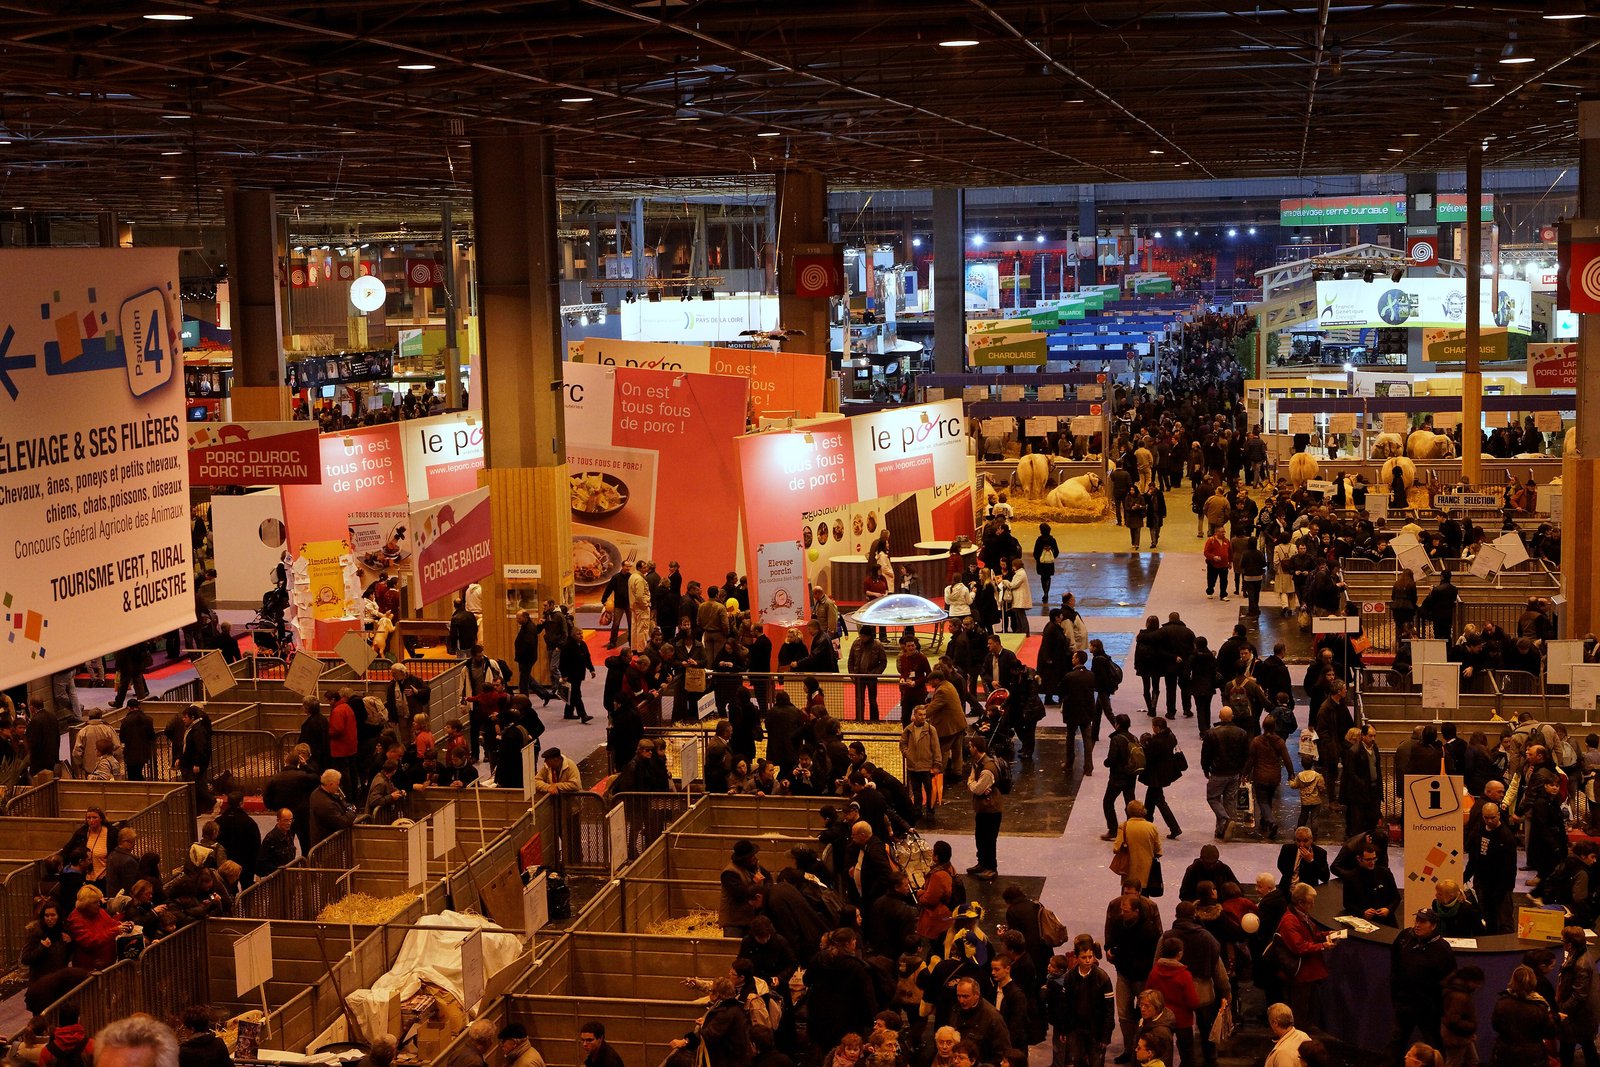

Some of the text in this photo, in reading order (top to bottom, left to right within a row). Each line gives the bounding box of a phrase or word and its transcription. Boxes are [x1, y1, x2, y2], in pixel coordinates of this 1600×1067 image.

[134, 310, 143, 376] Pavillon
[144, 310, 163, 374] 4
[1443, 346, 1496, 354] CHAAISE
[598, 351, 615, 366] le
[715, 360, 757, 376] On est
[622, 382, 670, 399] On est
[621, 400, 691, 417] tous fous
[620, 417, 638, 430] de
[643, 420, 675, 434] porc
[871, 414, 960, 452] le porc
[74, 432, 85, 460] &
[89, 426, 117, 458] SES
[121, 414, 179, 451] FILIÈRES
[368, 438, 390, 453] est
[421, 430, 443, 454] le
[822, 434, 843, 449] est
[206, 451, 300, 463] PORC DUROC
[578, 457, 592, 466] TOUS
[595, 459, 611, 468] FOUS
[613, 460, 620, 469] DE
[816, 454, 844, 468] fous
[879, 458, 931, 472] www.leporc.com
[47, 476, 73, 495] ânes,
[76, 472, 107, 493] poneys
[110, 466, 118, 482] et
[121, 462, 144, 482] petits
[146, 455, 180, 475] chevaux,
[200, 465, 308, 478] PORC PIETRAIN
[326, 456, 392, 477] tous fous
[333, 480, 350, 493] de
[355, 474, 384, 492] porc
[789, 477, 805, 491] de
[810, 472, 837, 490] porc
[46, 504, 80, 523] chiens,
[152, 480, 182, 498] oiseaux
[14, 504, 184, 559] Concours Général Agricole des Animaux
[423, 539, 491, 583] PORC DE BAYEUX
[50, 543, 185, 601] TOURISME VERT, RURAL
[770, 567, 791, 577] porcin
[123, 572, 186, 612] & ÉQUESTRE
